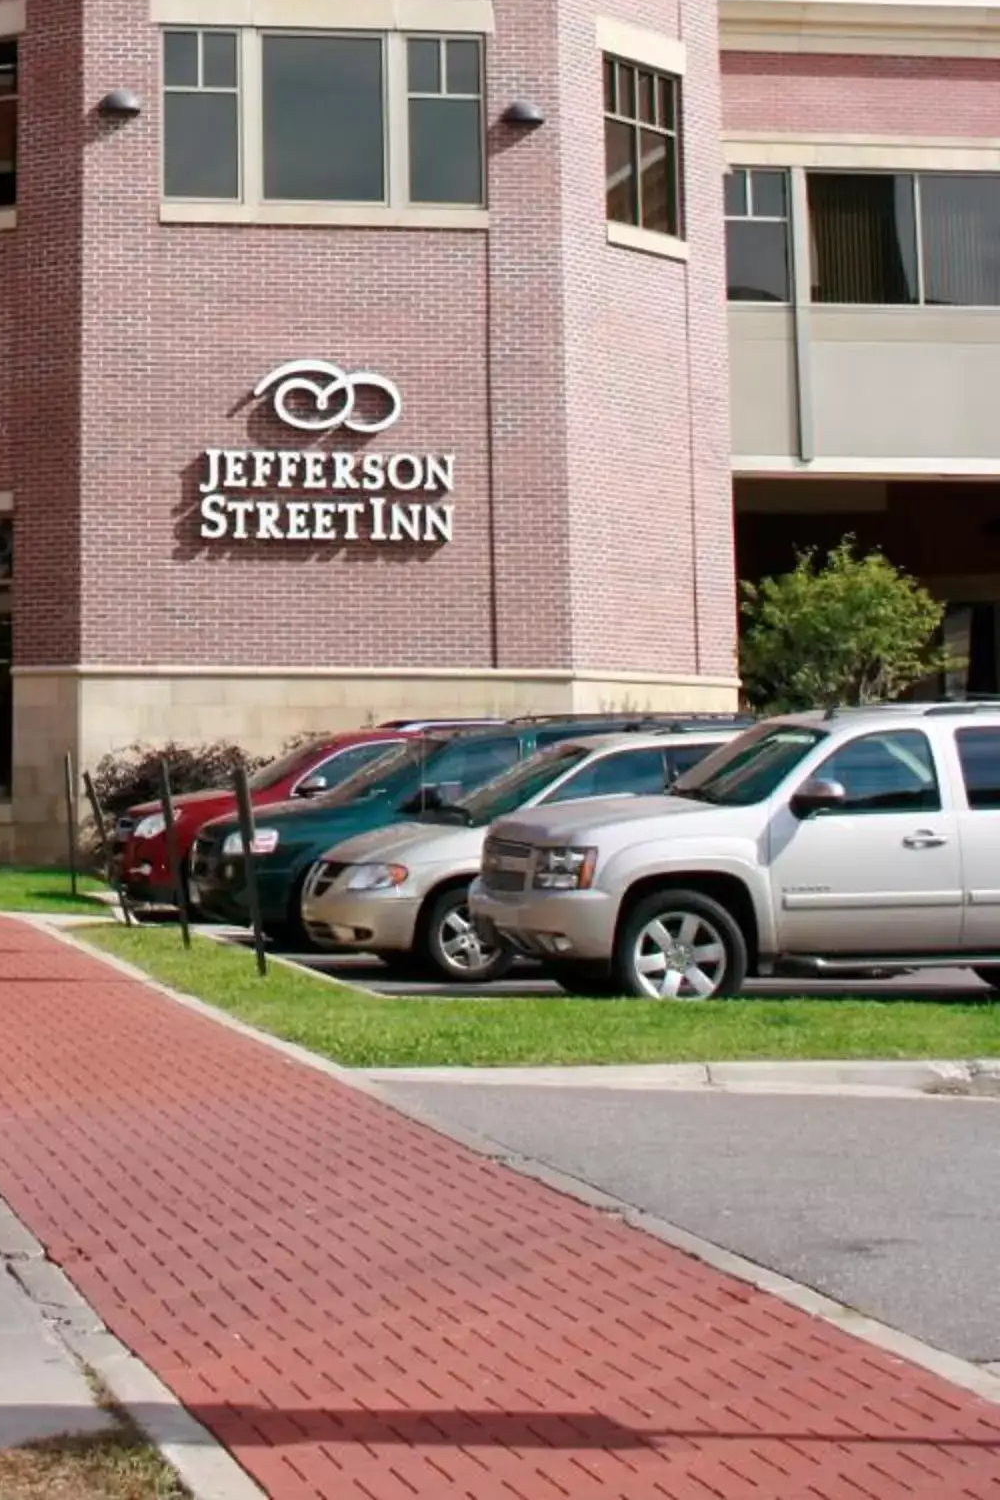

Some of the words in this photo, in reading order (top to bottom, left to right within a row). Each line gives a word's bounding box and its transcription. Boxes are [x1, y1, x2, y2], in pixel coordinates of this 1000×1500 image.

[199, 448, 456, 492] JEFFERSON
[201, 494, 365, 540] STREET
[369, 497, 455, 542] INN
